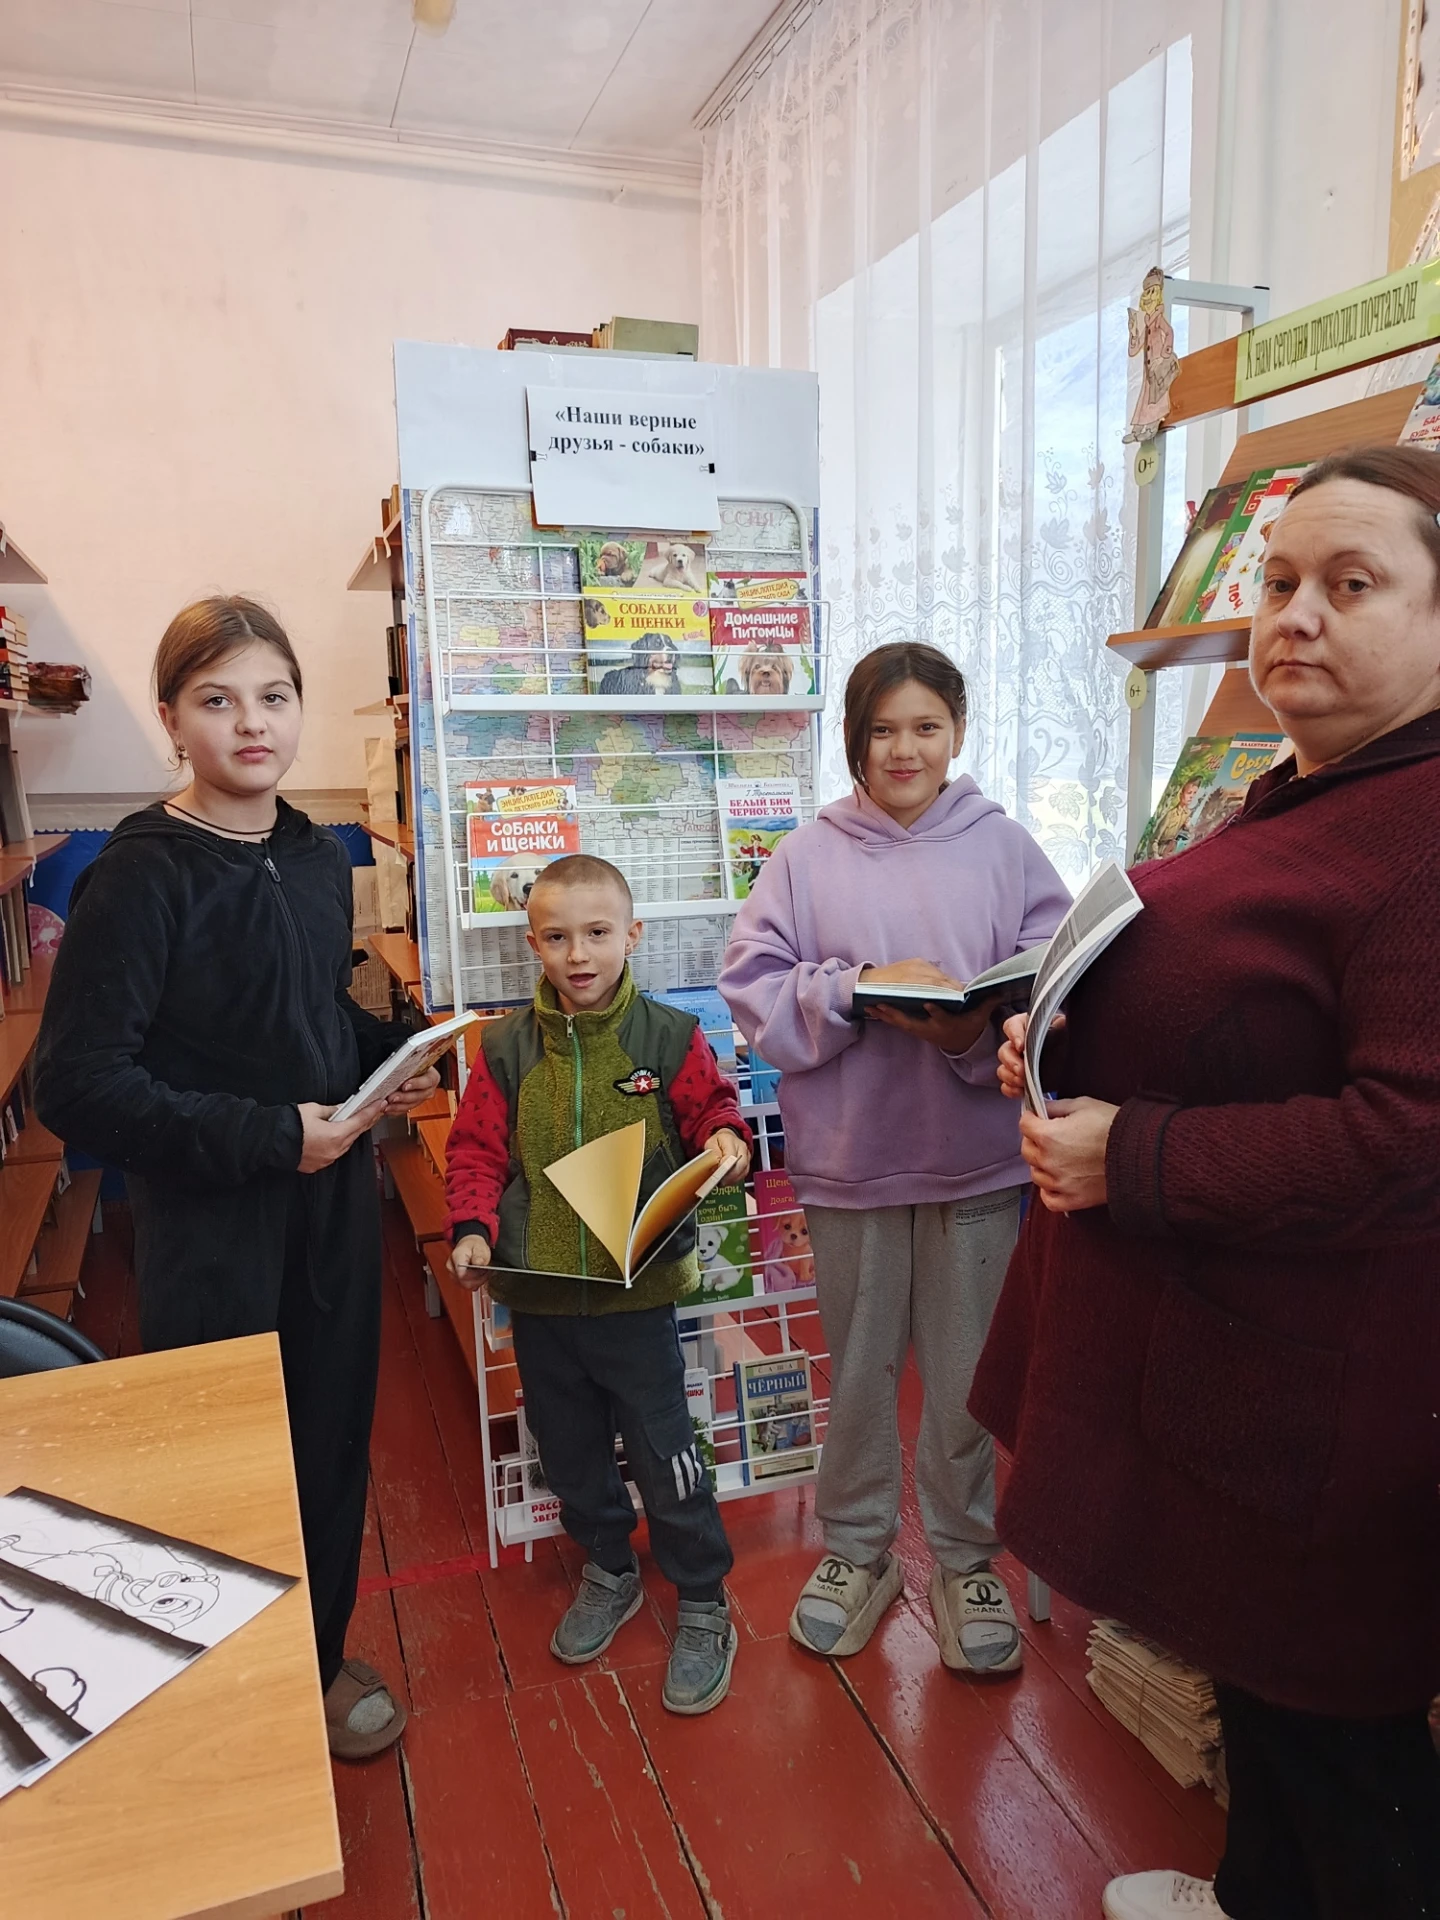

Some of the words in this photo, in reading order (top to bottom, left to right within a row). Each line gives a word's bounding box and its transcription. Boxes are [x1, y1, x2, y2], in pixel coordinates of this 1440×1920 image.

[1245, 328, 1255, 380] К
[1255, 337, 1271, 376] нам
[1273, 321, 1309, 370] сегодня
[1310, 303, 1358, 370] приходил
[1359, 280, 1419, 339] почтальон
[555, 405, 622, 426] «Наши
[629, 413, 697, 432] верные
[548, 435, 614, 455] друзья
[632, 437, 705, 456] собаки»
[1138, 457, 1155, 474] 0+
[619, 603, 678, 615] СОБАКИ
[614, 617, 625, 628] И
[631, 617, 686, 630] ЩЕНКИ
[1129, 684, 1141, 698] 6+
[500, 788, 555, 808] ЭНЦИКЛОПЕДИЯ
[541, 798, 557, 806] САДА
[729, 797, 767, 807] БЕЛЫЙ
[770, 798, 791, 806] БИМ
[729, 808, 770, 817] ЧЕРНОЕ
[772, 806, 793, 815] УХО
[718, 1204, 738, 1212] быть
[748, 1371, 805, 1393] ЧЁРНЫЙ
[964, 1606, 1009, 1616] CHANEL
